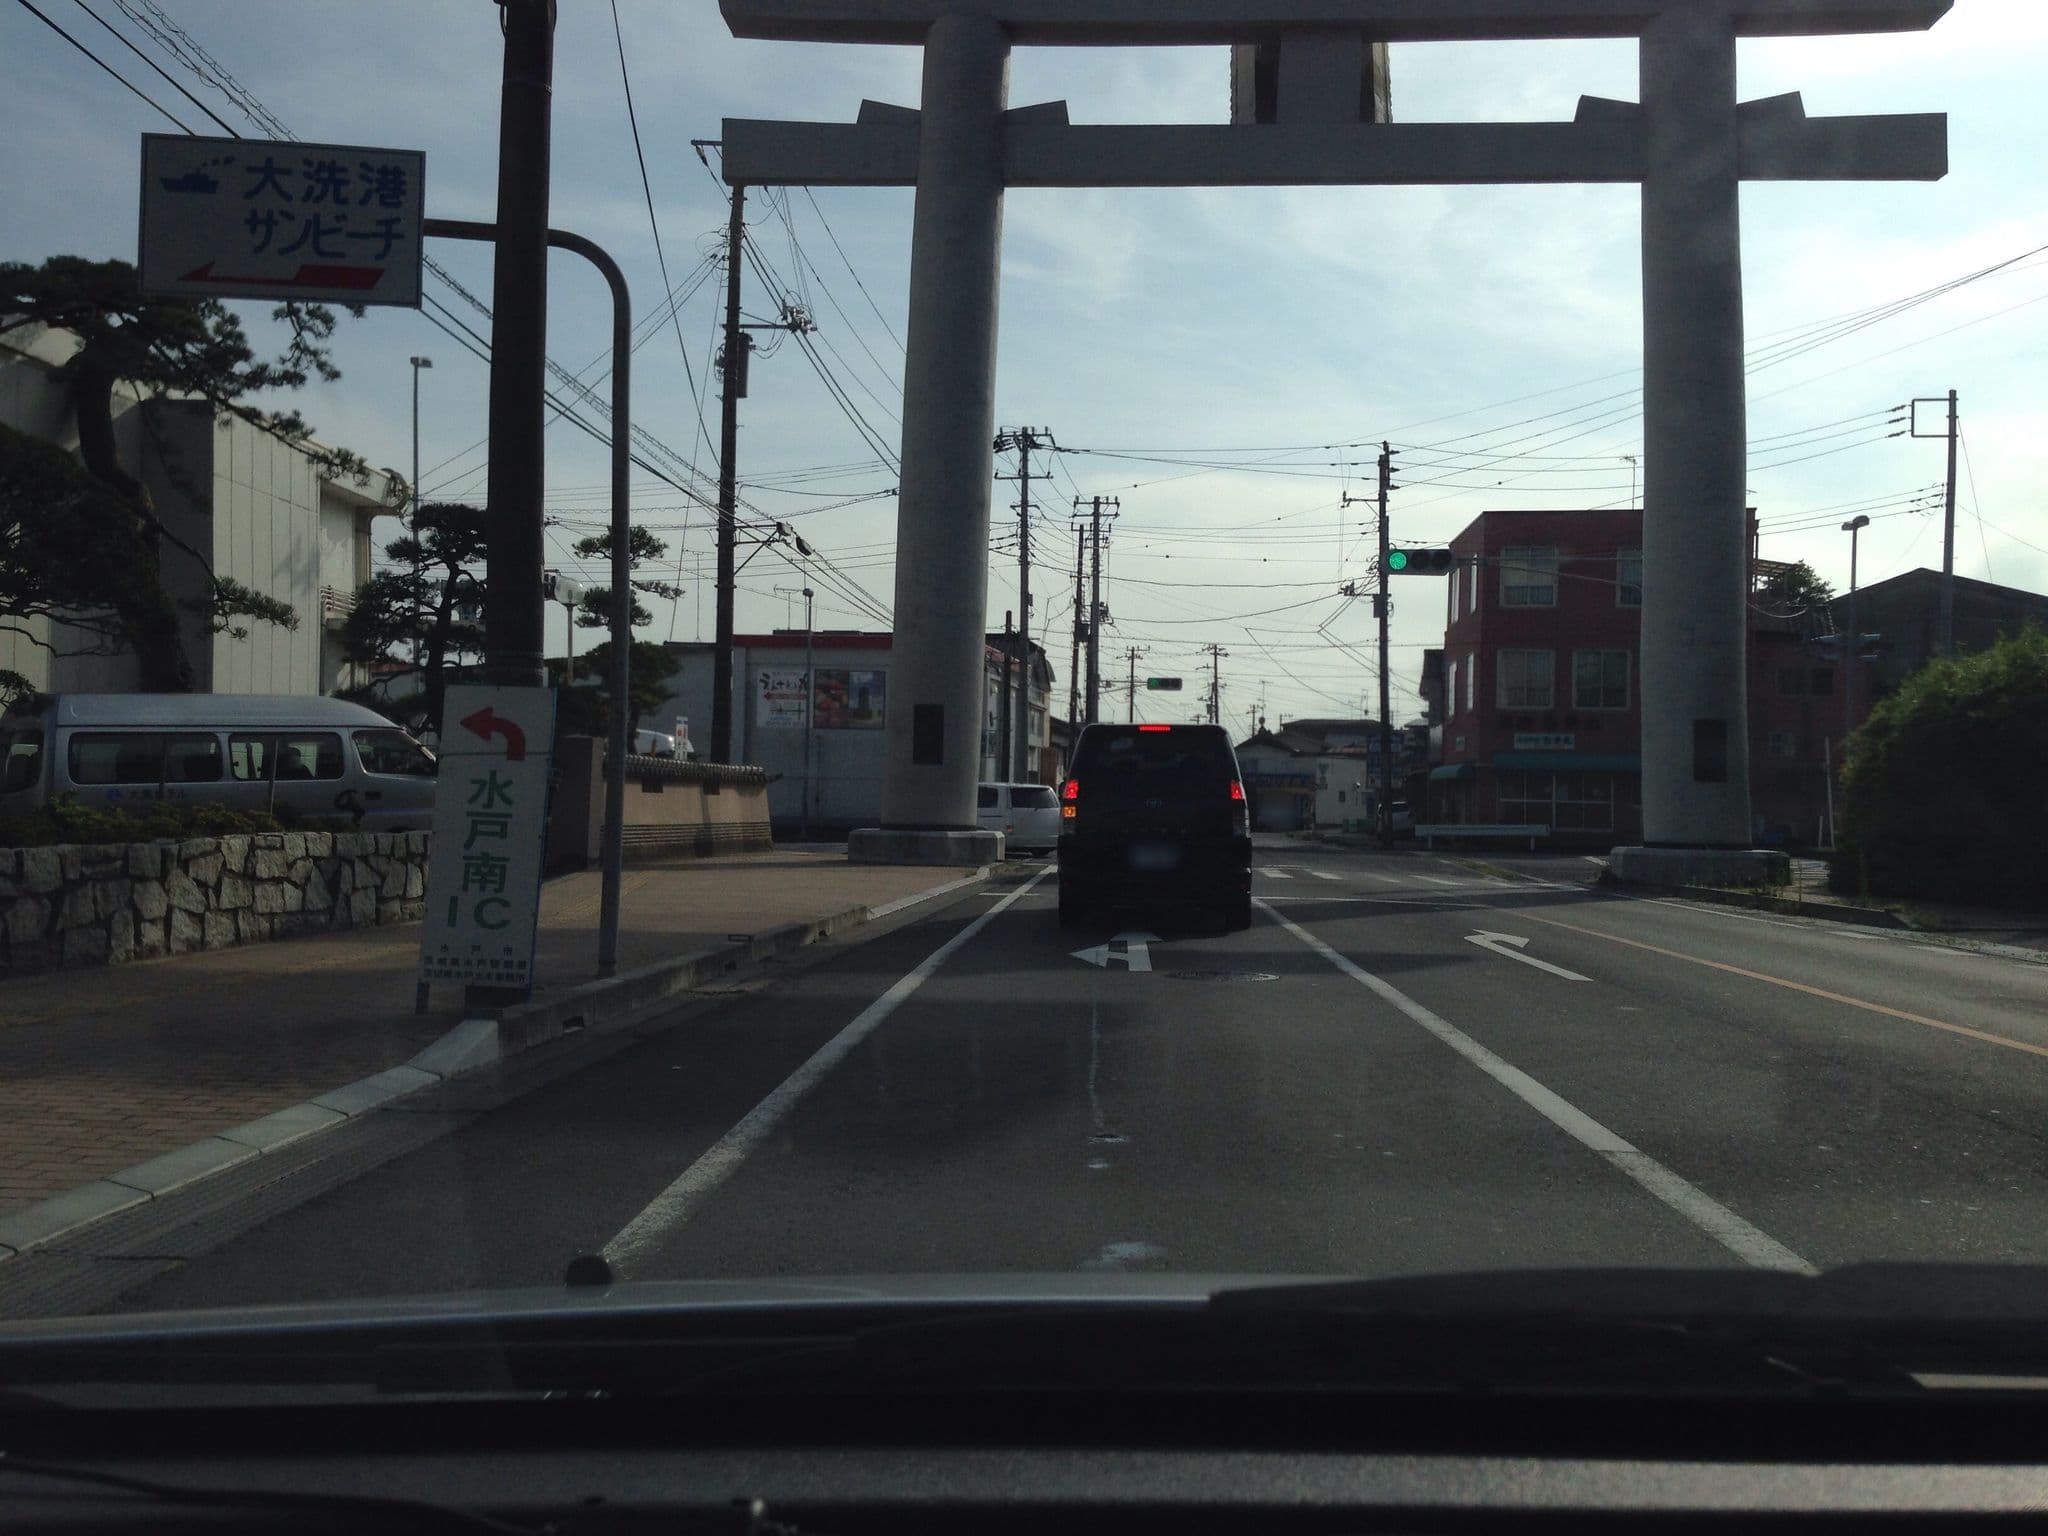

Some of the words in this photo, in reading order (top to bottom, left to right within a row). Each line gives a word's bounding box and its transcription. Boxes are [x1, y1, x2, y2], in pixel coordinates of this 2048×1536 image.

[244, 157, 406, 207] 大洗港
[244, 209, 404, 260] サンビーチ
